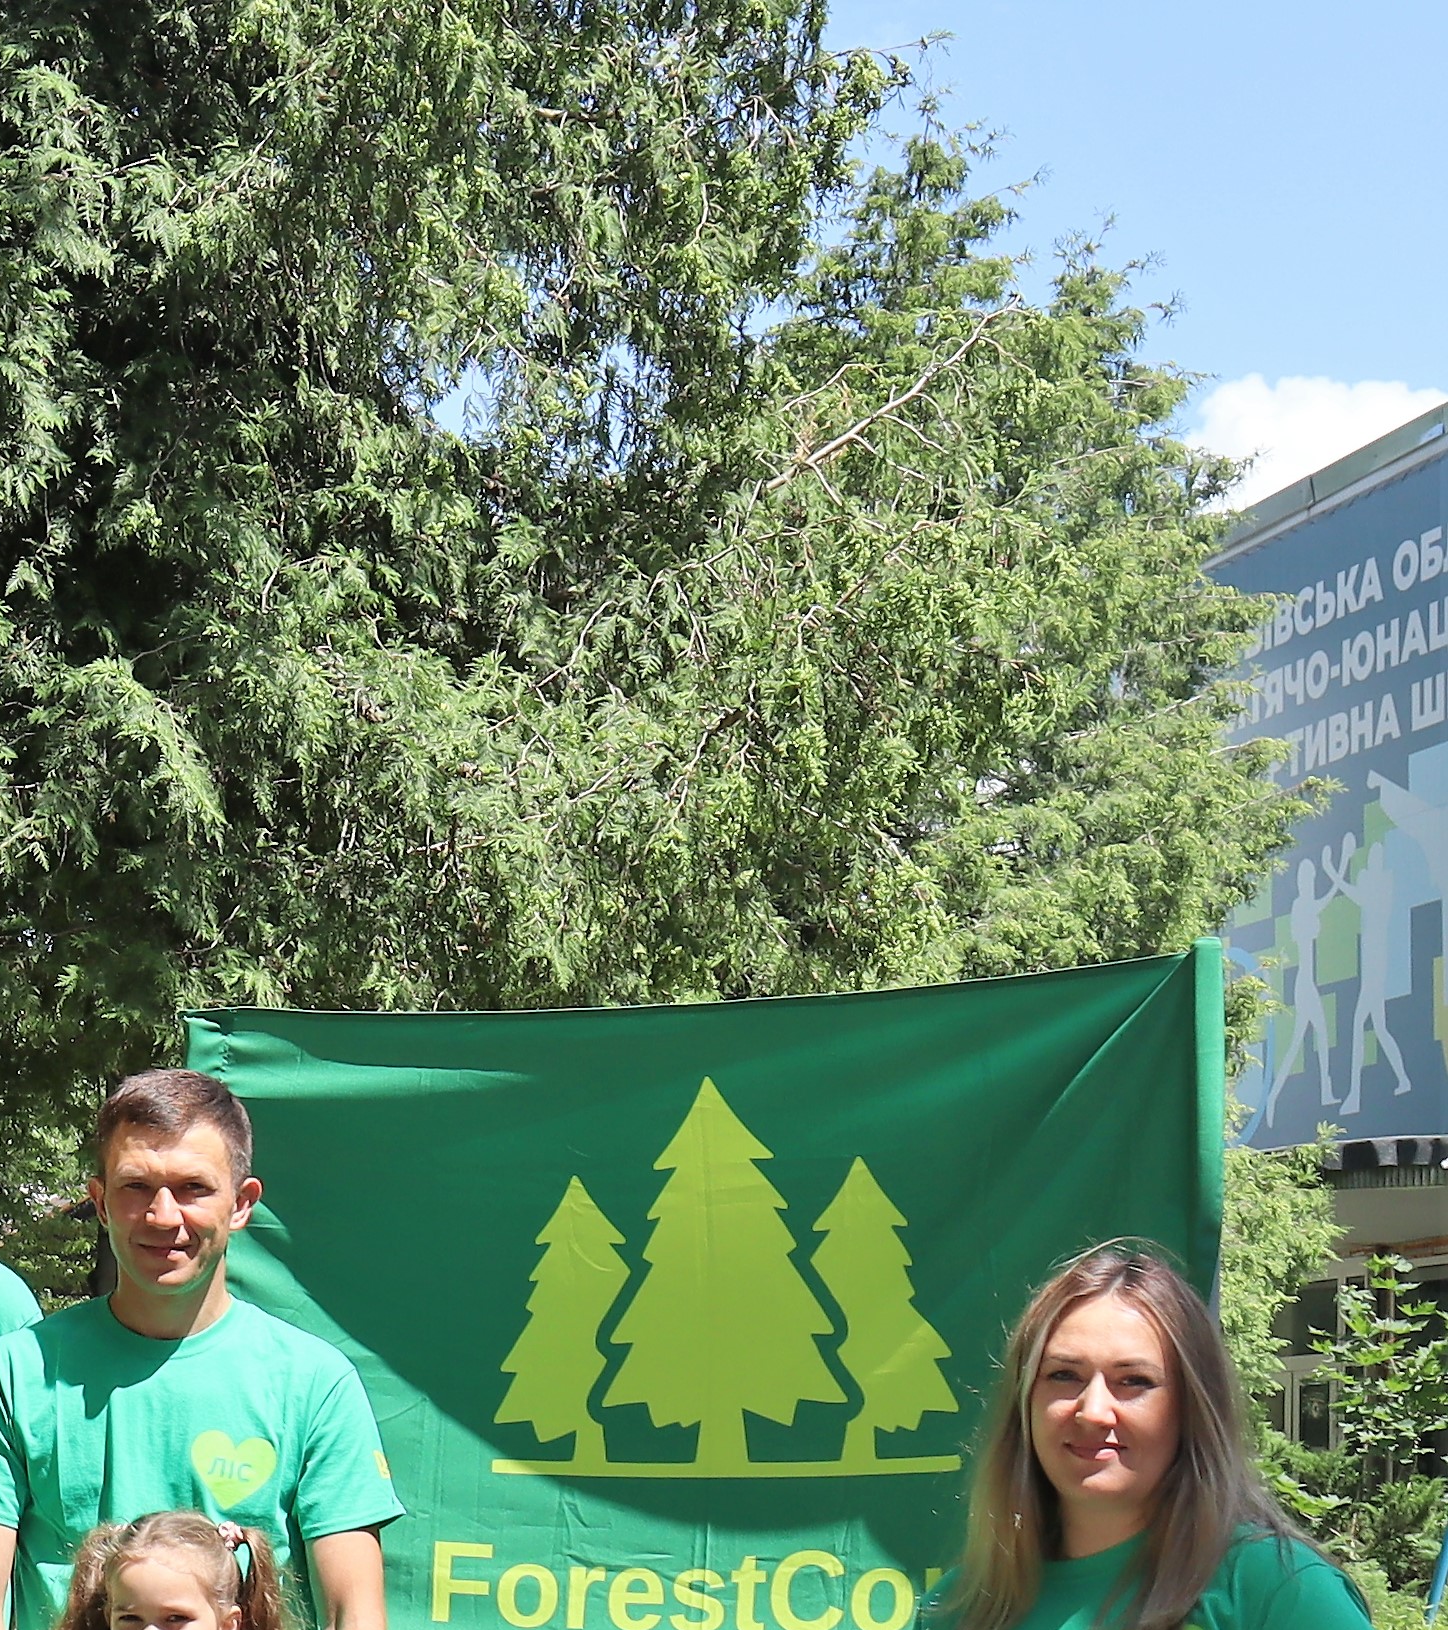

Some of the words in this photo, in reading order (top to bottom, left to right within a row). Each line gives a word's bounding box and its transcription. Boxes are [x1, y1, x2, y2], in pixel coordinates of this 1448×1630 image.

[1392, 525, 1448, 591] ОБ
[1411, 672, 1448, 732] Ш
[206, 1457, 252, 1482] ЛІС
